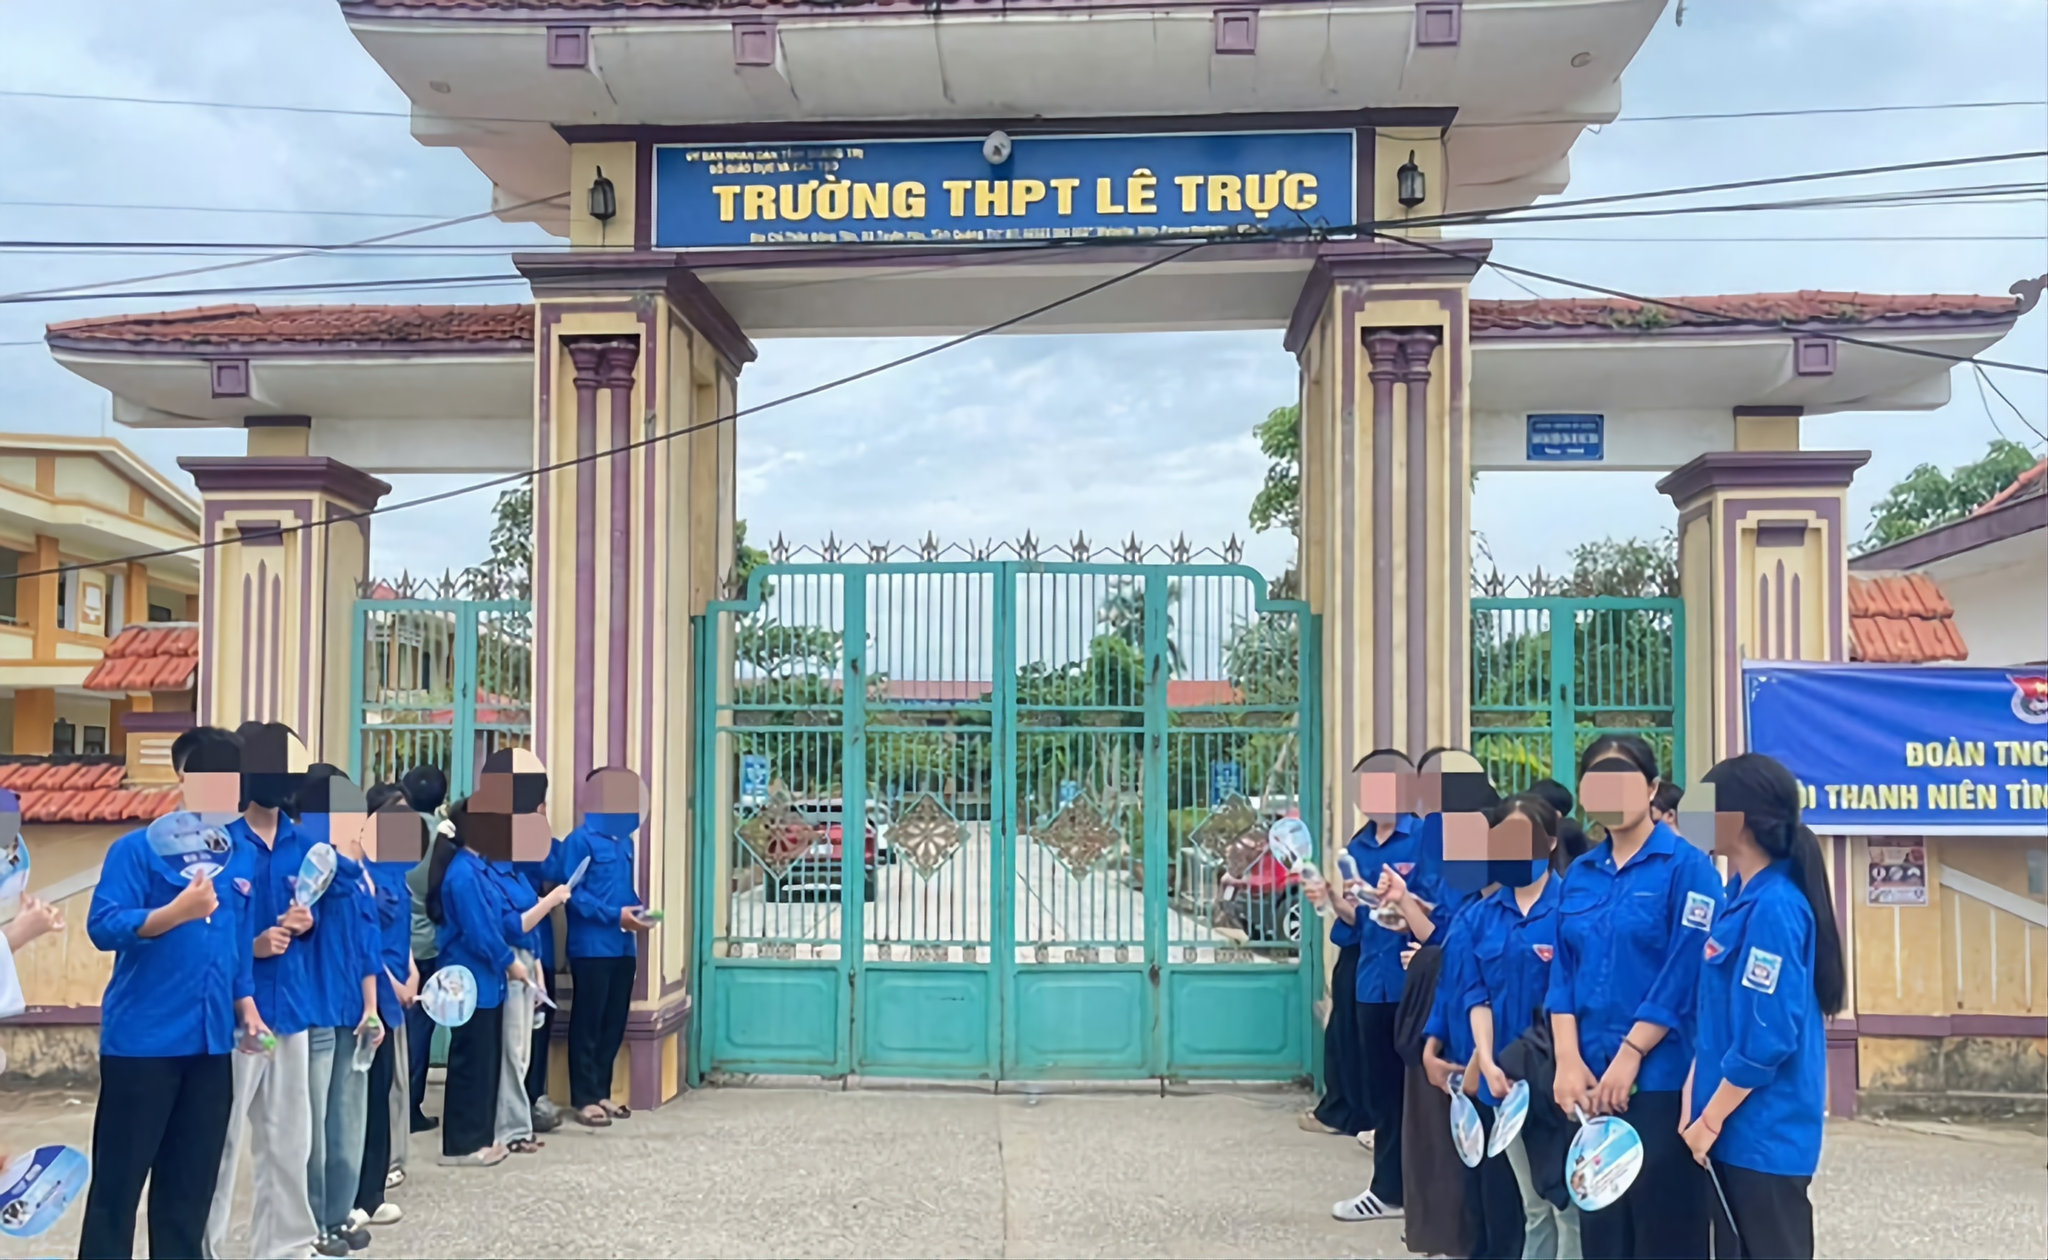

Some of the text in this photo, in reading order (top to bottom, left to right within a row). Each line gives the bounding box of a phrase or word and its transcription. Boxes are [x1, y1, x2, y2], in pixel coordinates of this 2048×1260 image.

[712, 167, 1319, 222] TRƯỜNG THPT LÊ TRỰC
[1906, 736, 1986, 767] ĐOÀN
[1824, 784, 1919, 810] THANH
[1927, 779, 1997, 810] NIÊN
